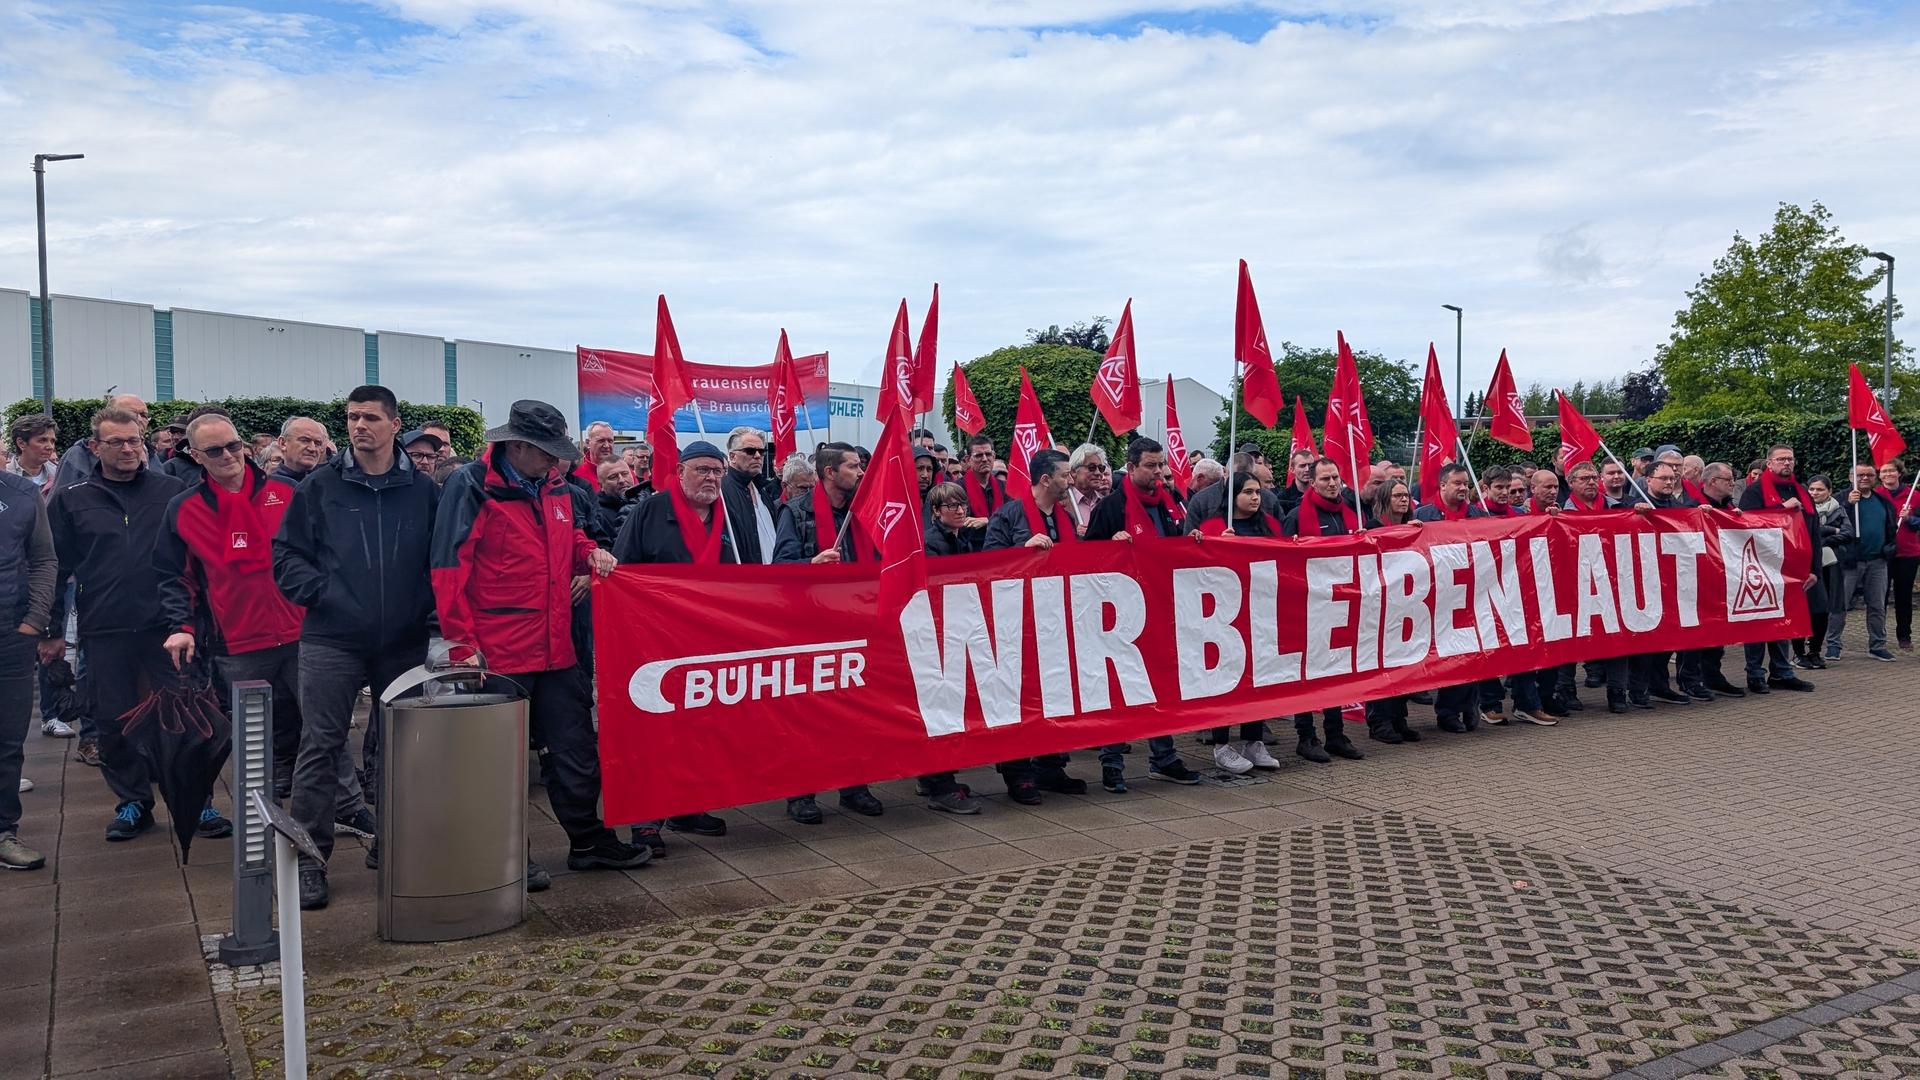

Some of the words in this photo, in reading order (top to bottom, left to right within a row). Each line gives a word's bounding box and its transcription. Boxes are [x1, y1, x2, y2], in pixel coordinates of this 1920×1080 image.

[692, 376, 770, 389] rauensleu
[829, 400, 864, 417] ÜHLER
[899, 572, 1157, 737] WIR
[1172, 538, 1529, 700] BLEIBEN
[1529, 531, 1707, 642] LAUT
[684, 652, 866, 709] BÜHLER
